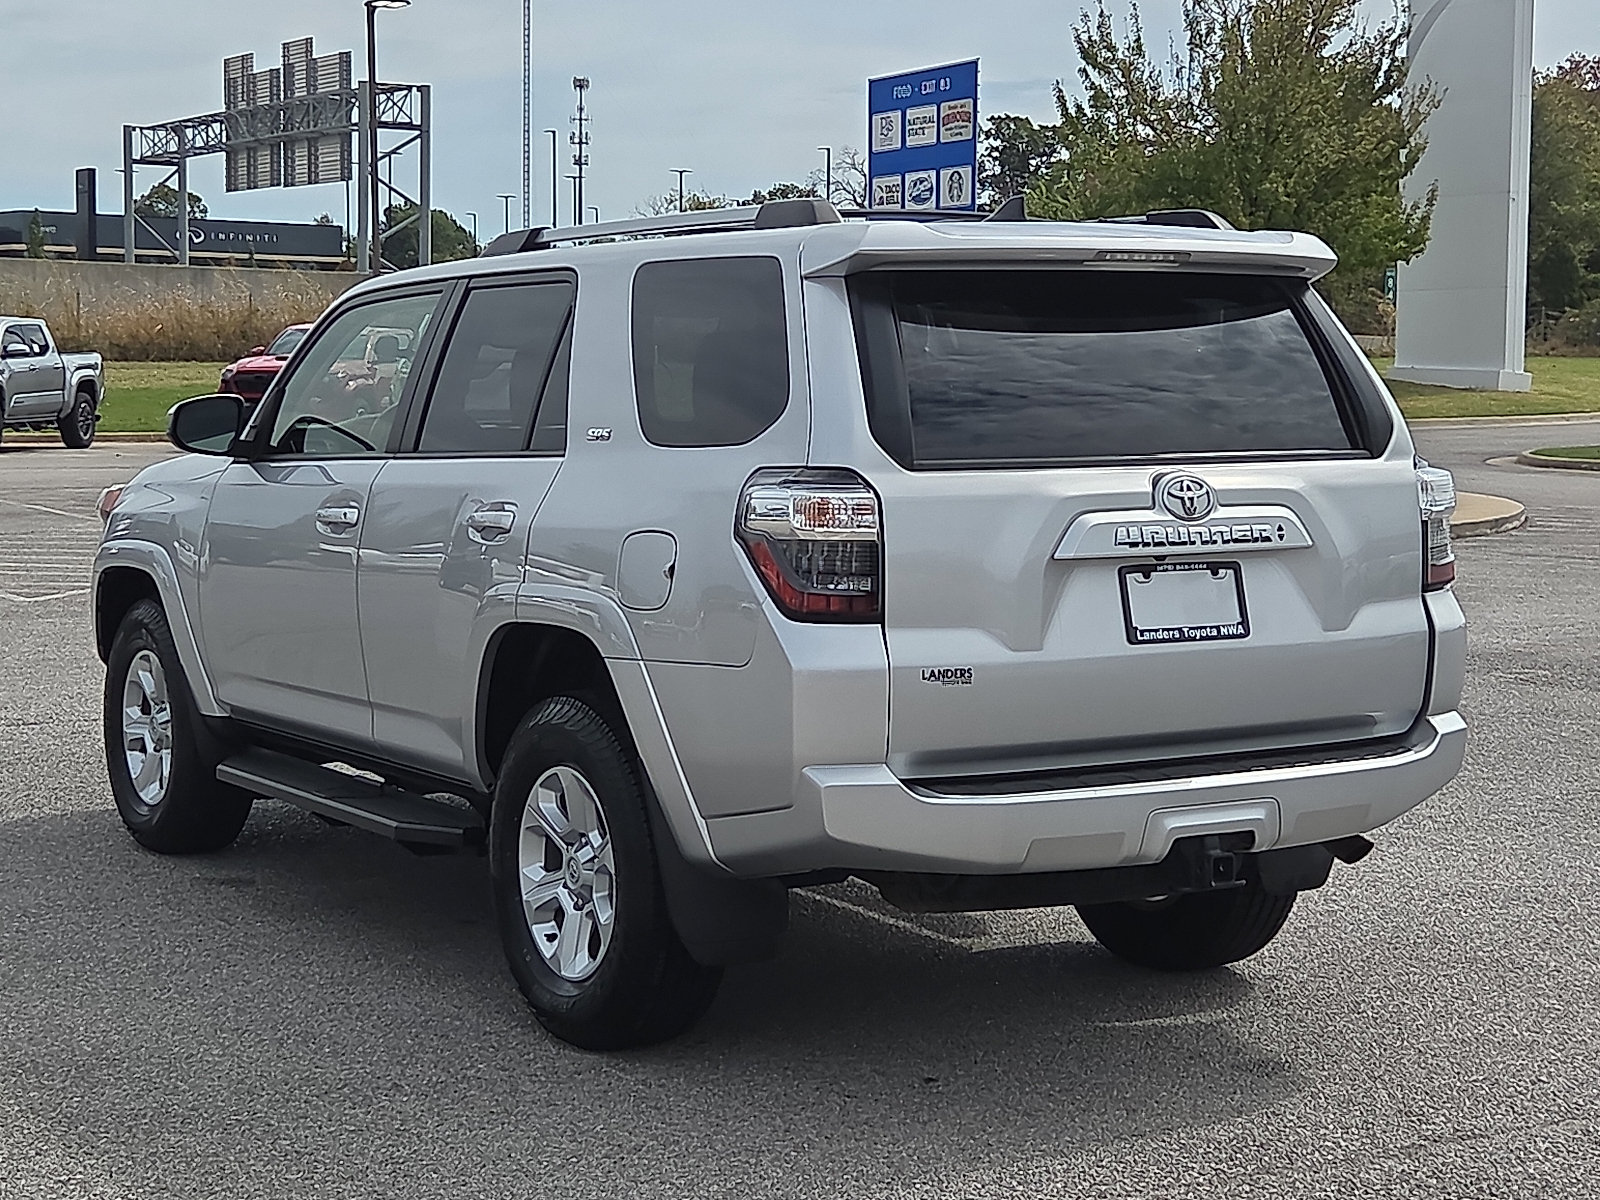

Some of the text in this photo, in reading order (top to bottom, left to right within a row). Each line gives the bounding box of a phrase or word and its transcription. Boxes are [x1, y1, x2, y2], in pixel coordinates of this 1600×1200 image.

[907, 114, 936, 127] NATURAL
[907, 126, 927, 138] STATE
[884, 183, 901, 194] TACO
[211, 231, 278, 243] INFINITI
[1137, 624, 1245, 640] Landers Toyota NWA
[921, 667, 973, 681] LANDERS
